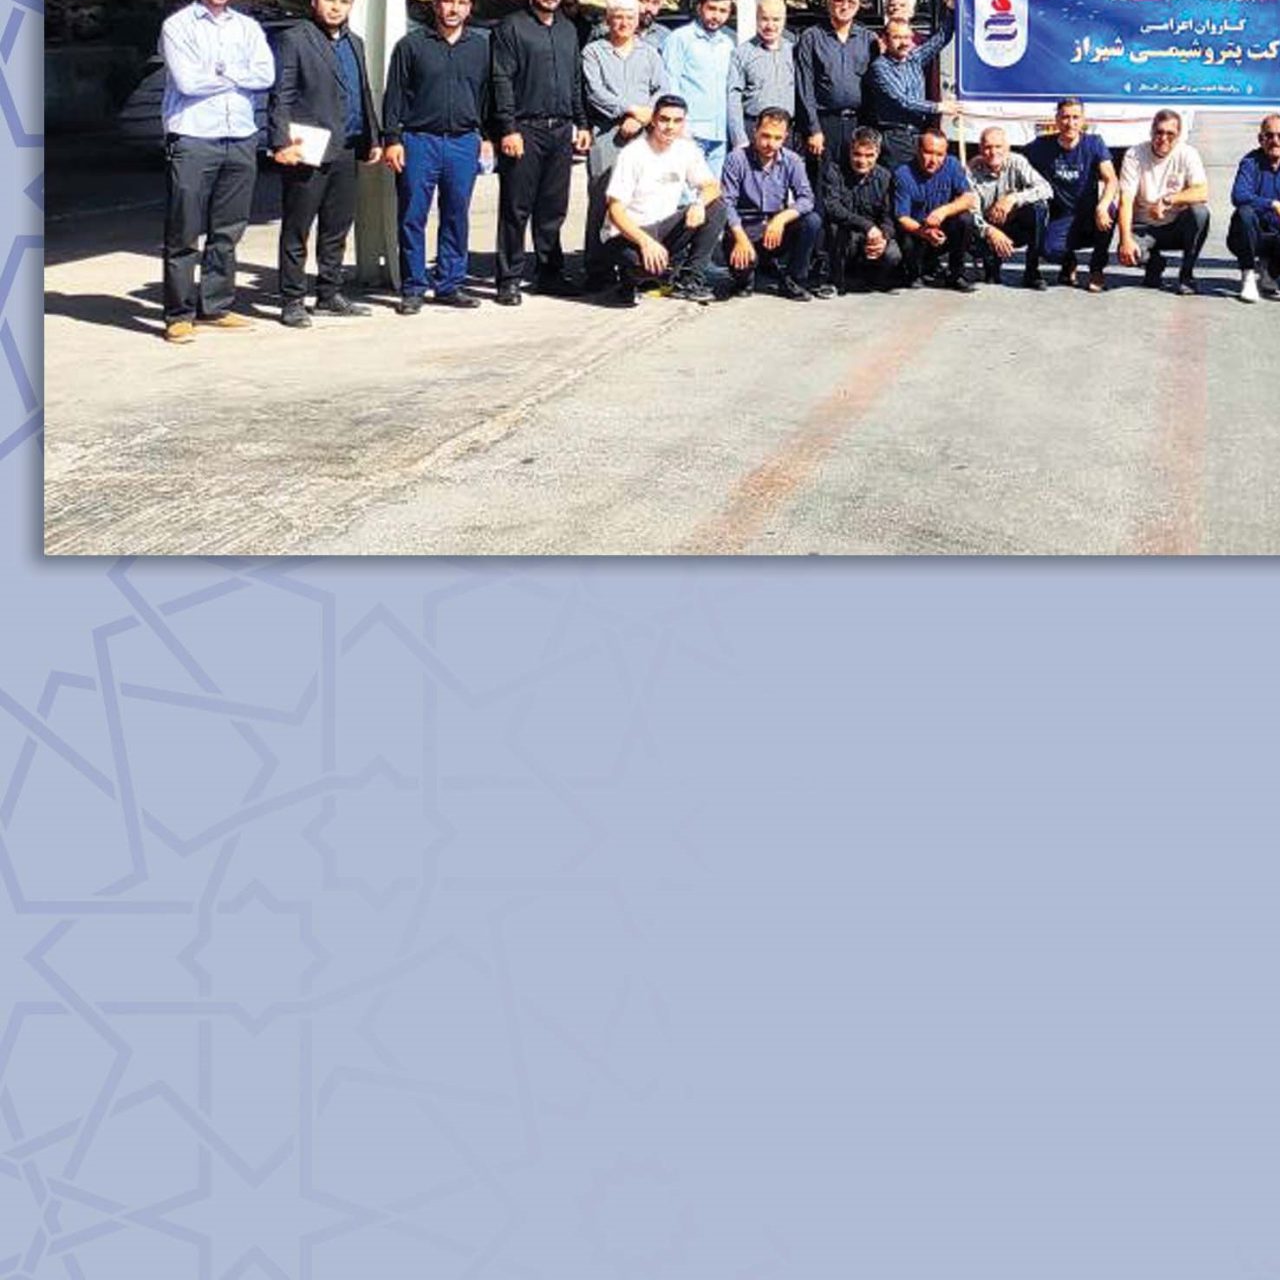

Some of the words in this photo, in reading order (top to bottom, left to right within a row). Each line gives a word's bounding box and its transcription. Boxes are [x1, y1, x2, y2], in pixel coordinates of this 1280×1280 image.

[1195, 17, 1247, 35] کاروان
[1070, 35, 1125, 65] شیراز
[1129, 38, 1243, 67] پتروشیمی
